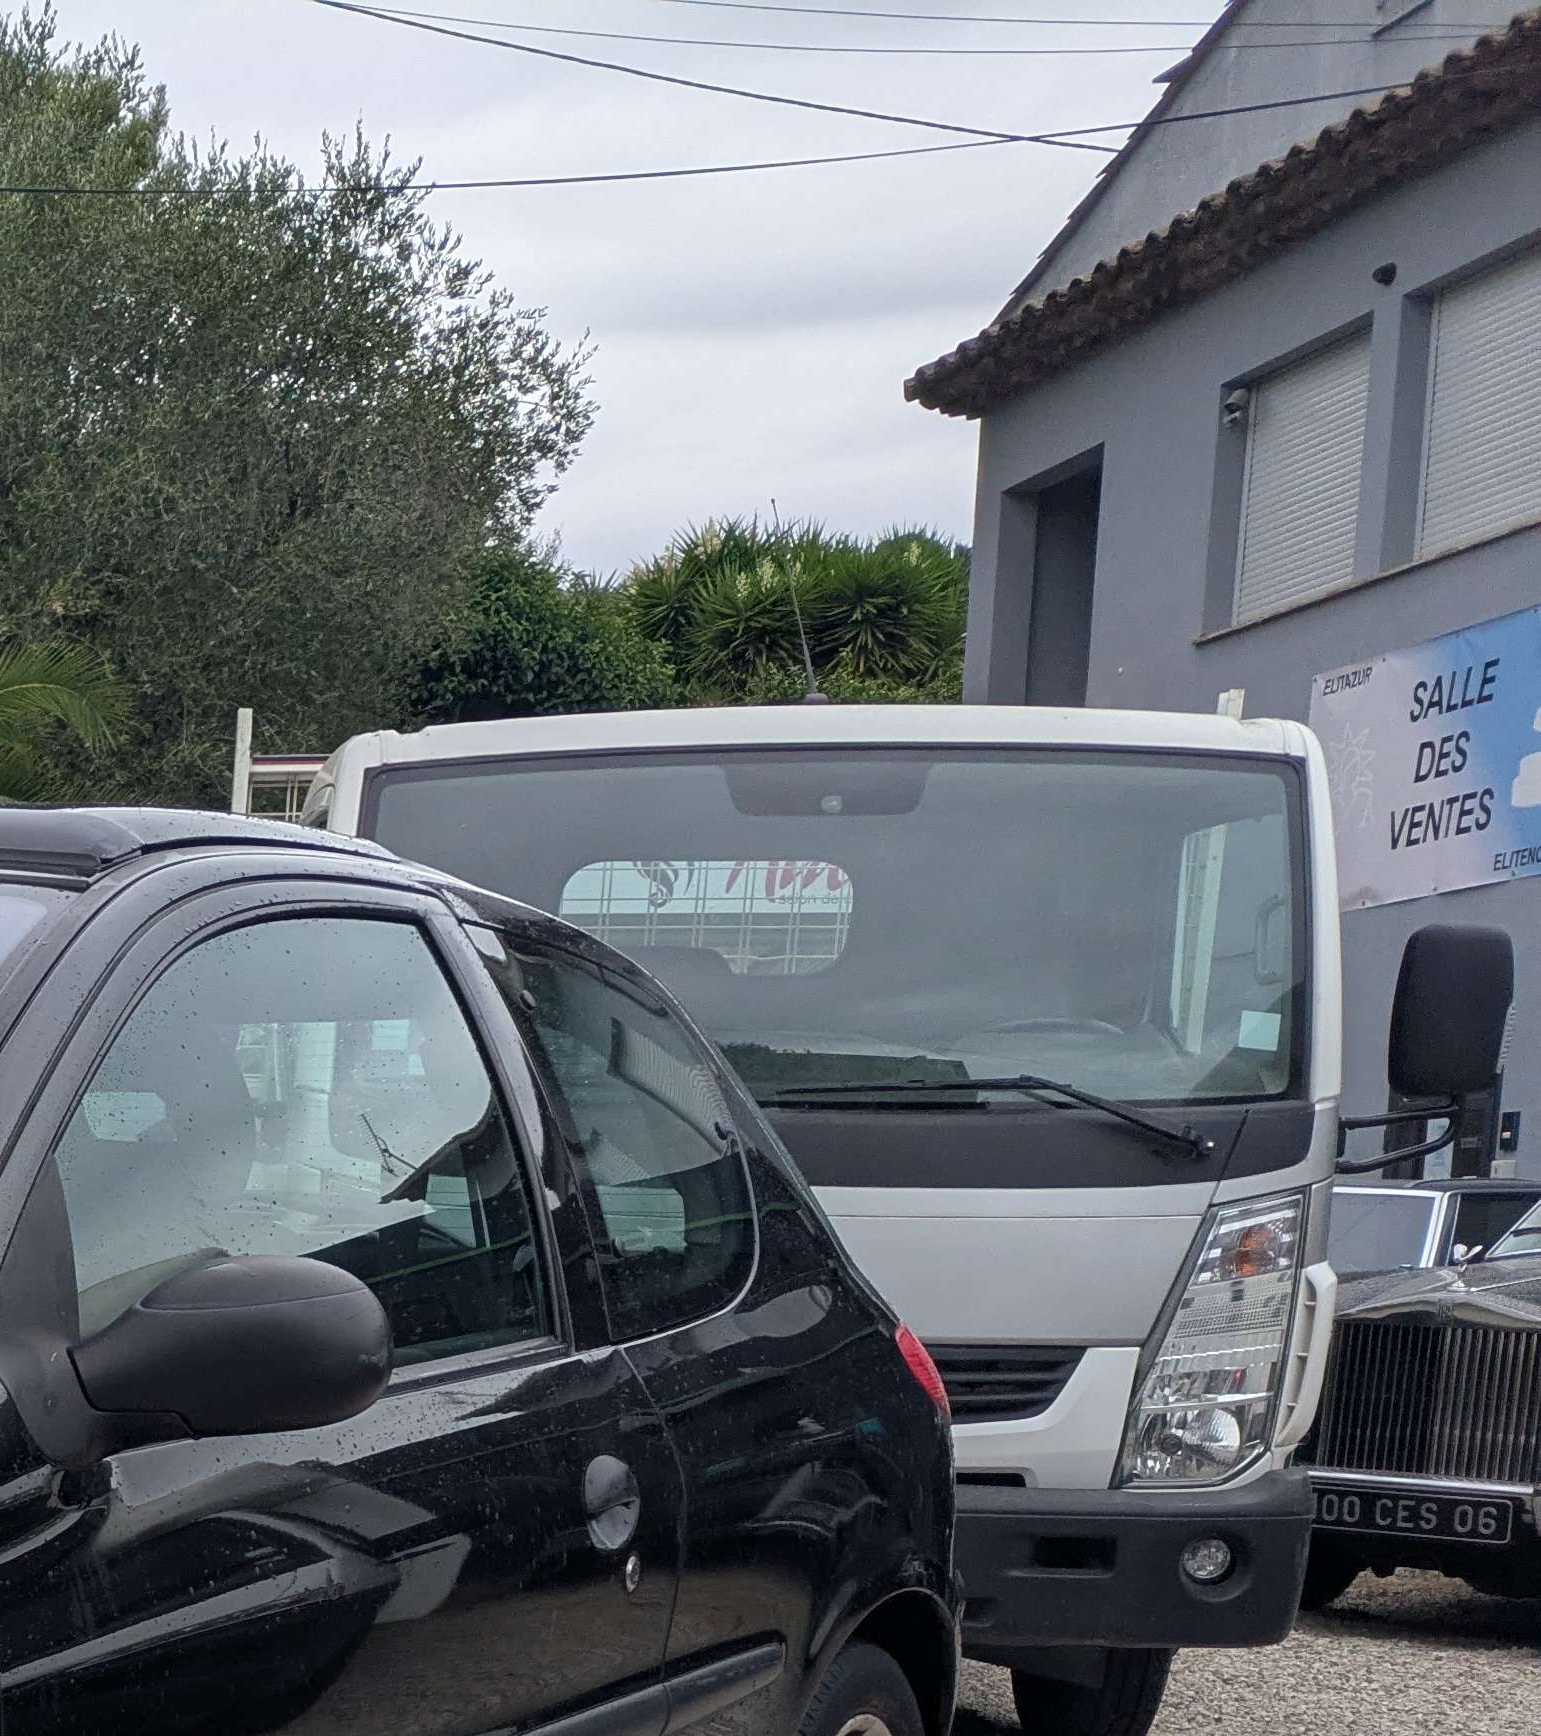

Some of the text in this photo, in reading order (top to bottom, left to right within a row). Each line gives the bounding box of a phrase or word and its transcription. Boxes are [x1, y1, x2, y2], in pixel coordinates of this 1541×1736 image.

[1322, 667, 1373, 697] ELITAZUR
[1409, 658, 1500, 722] SALLE
[1413, 730, 1471, 784] DES
[1389, 788, 1495, 850] VENTES
[1375, 1498, 1438, 1530] CES
[1453, 1504, 1498, 1535] 06
